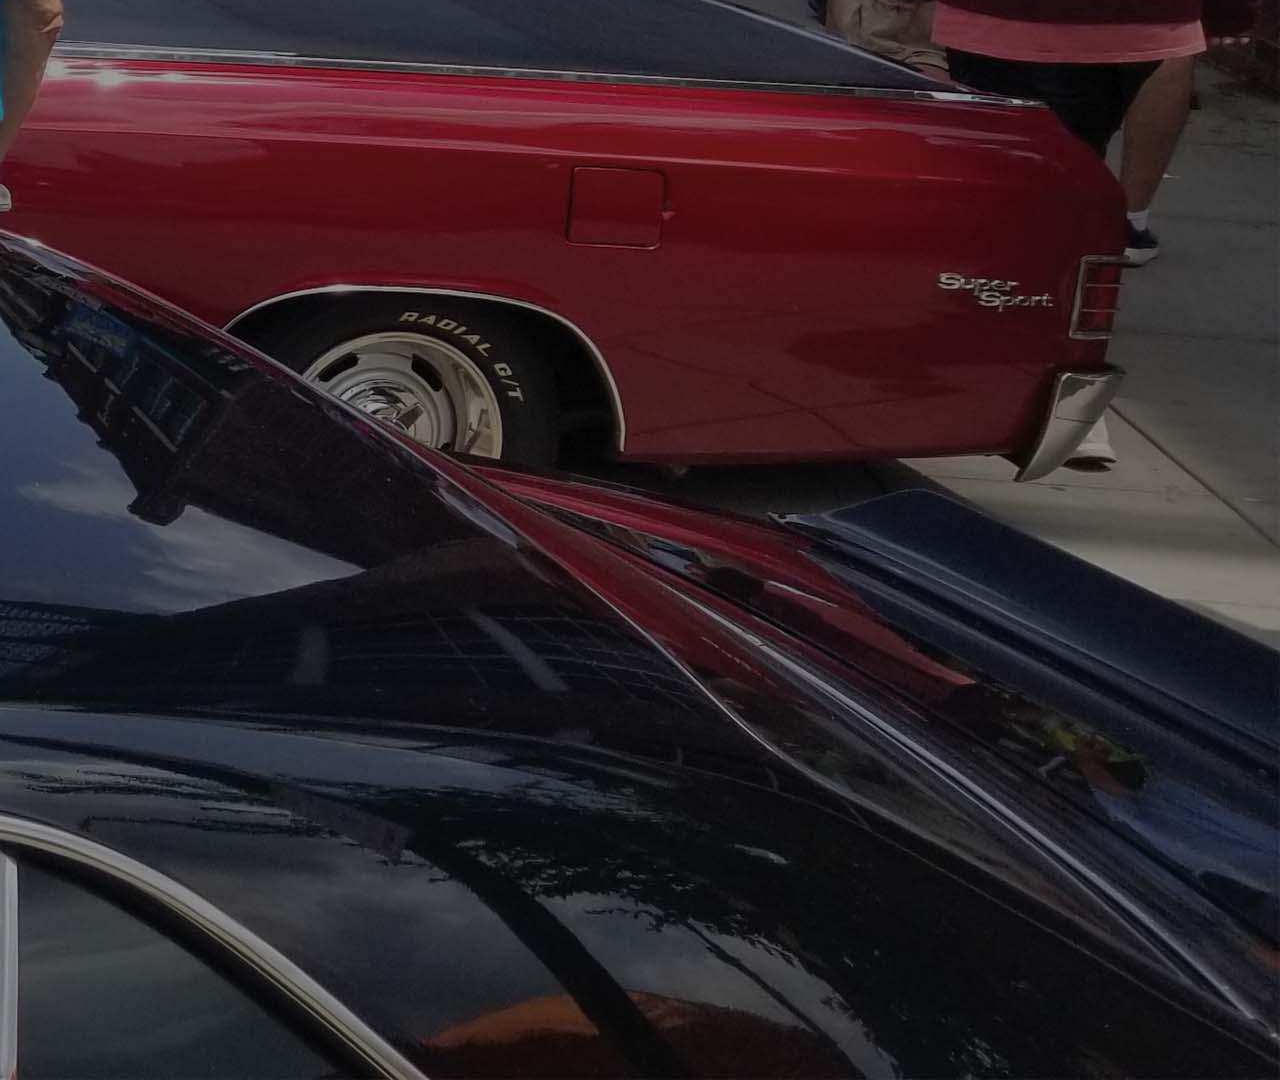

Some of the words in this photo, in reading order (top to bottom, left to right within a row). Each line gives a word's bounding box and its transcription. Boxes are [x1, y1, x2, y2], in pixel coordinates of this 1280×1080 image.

[936, 272, 1021, 296] Super
[977, 290, 1055, 313] Sport
[399, 311, 492, 357] RADIAL
